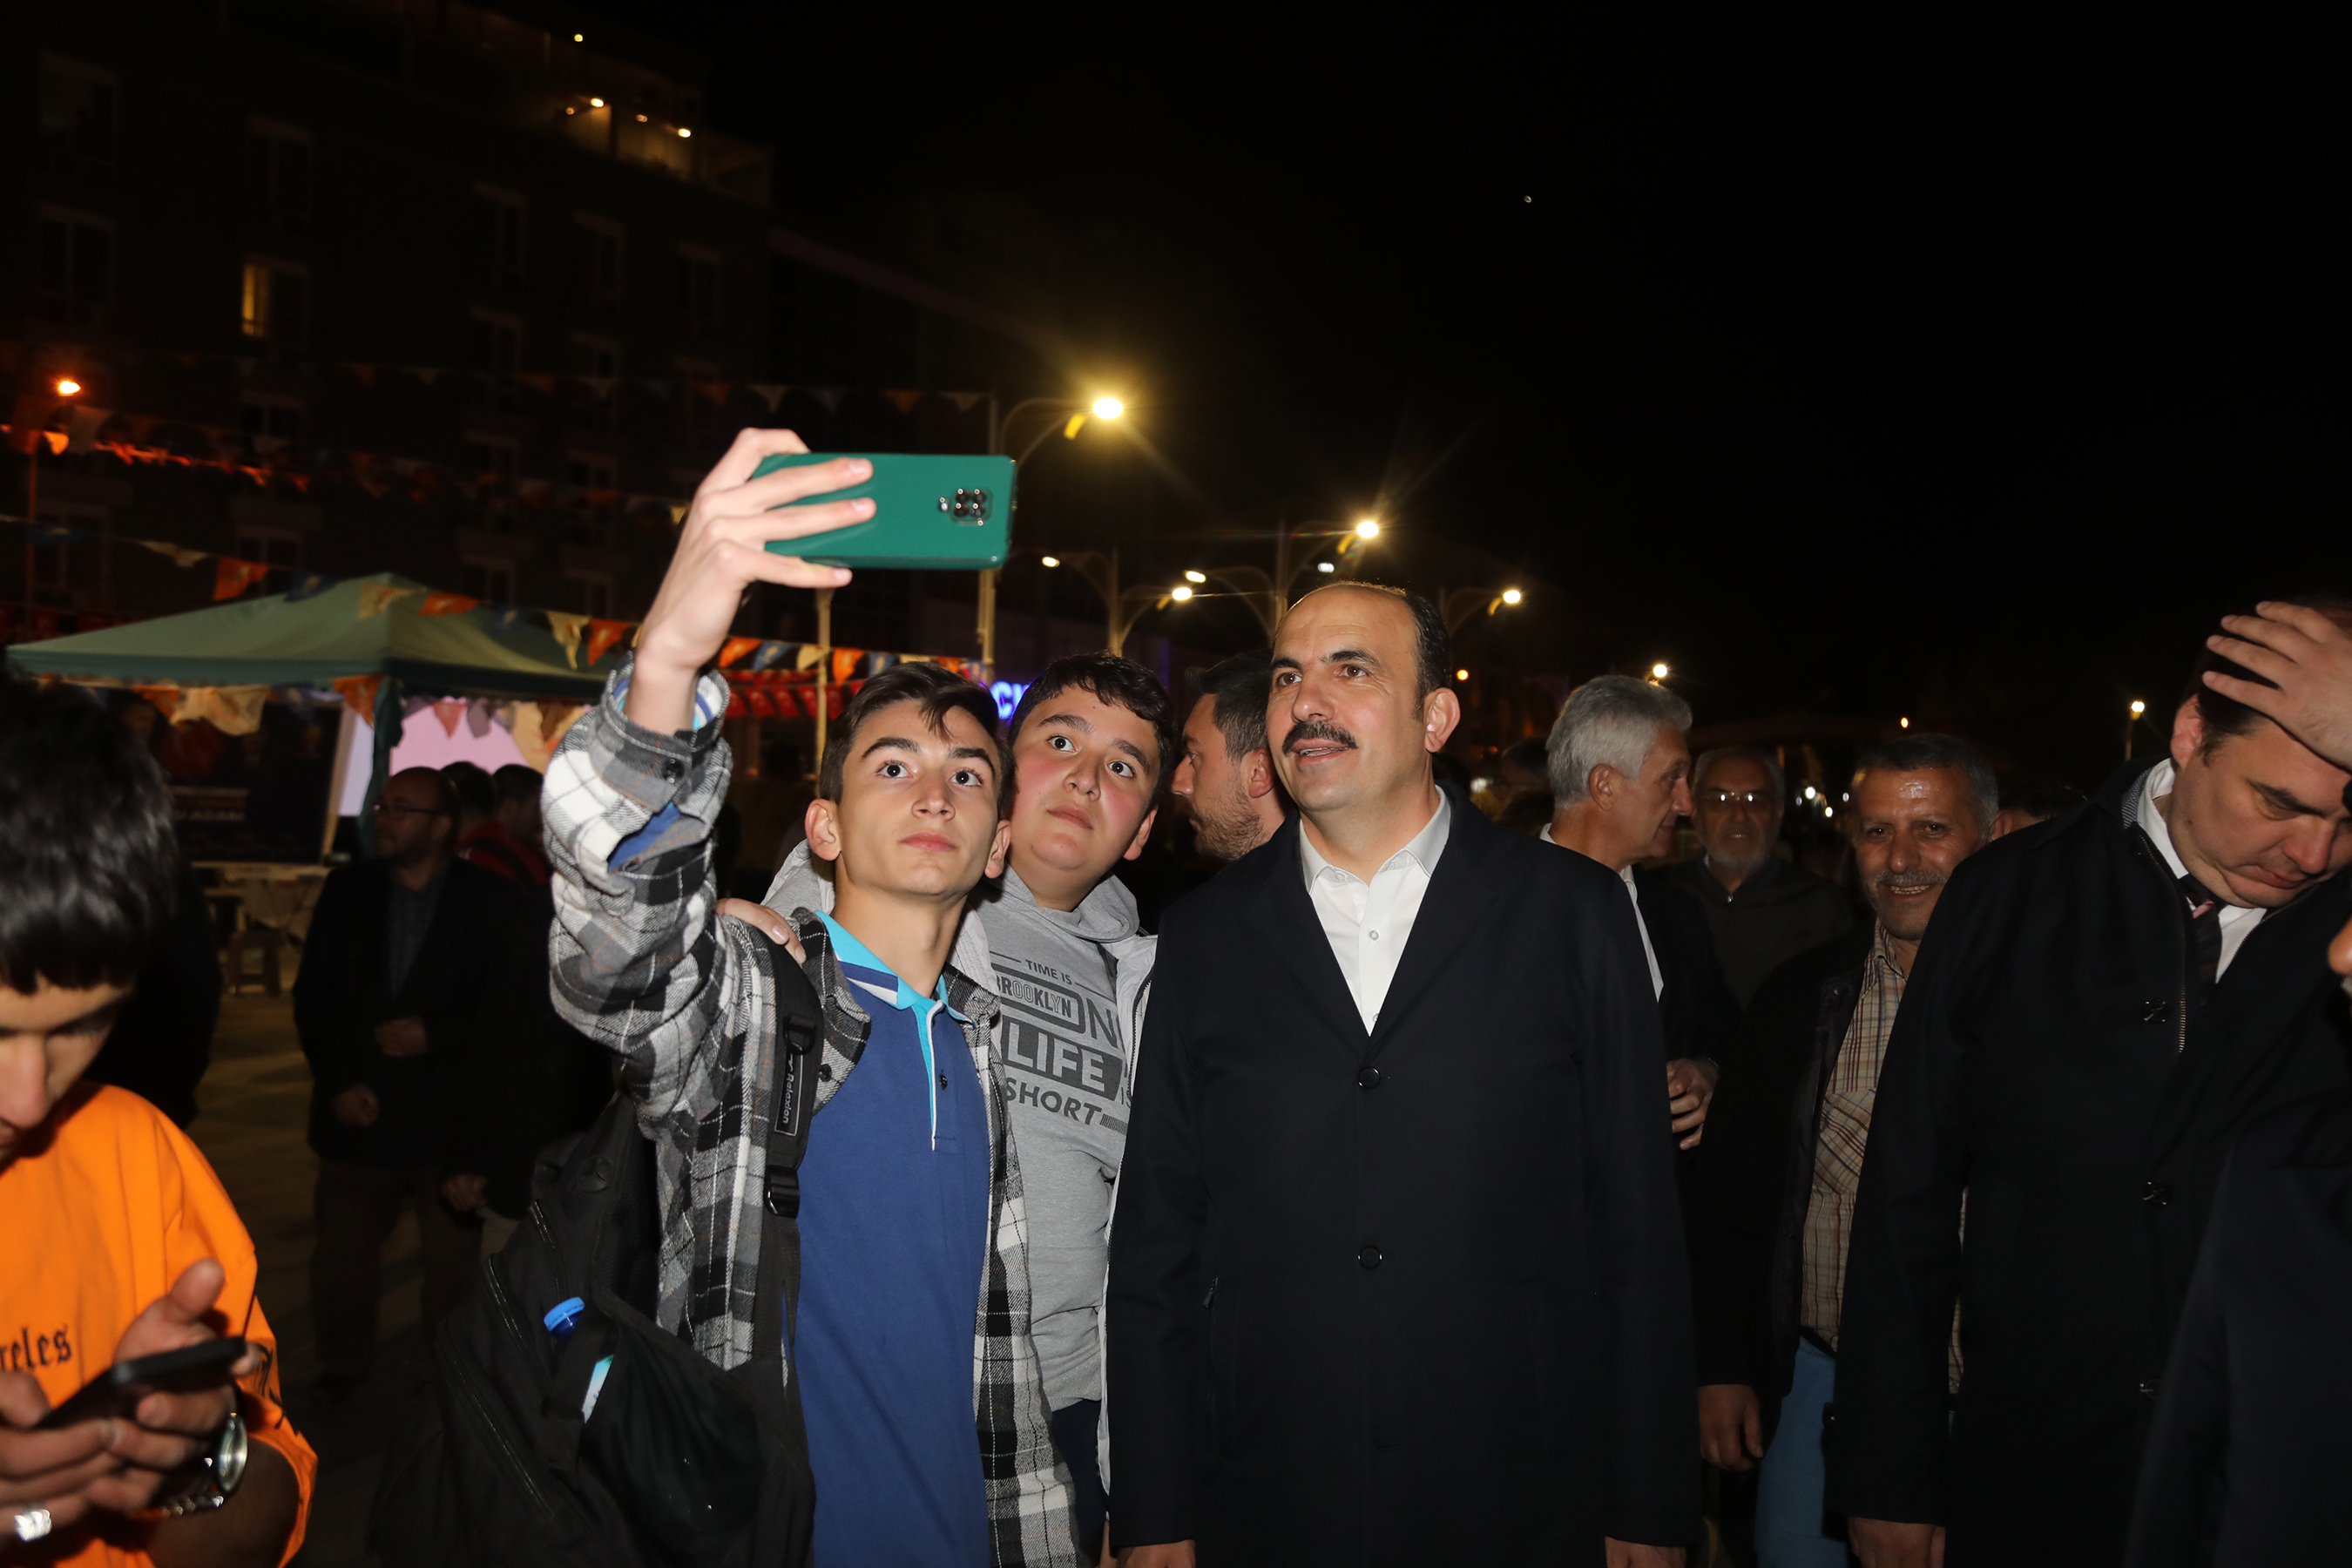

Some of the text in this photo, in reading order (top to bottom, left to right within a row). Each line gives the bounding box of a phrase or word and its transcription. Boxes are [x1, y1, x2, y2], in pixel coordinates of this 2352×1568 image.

[1025, 959, 1072, 985] TIME IS
[1008, 1022, 1105, 1092] LIFE
[782, 1073, 794, 1124] Relaxion
[1006, 1077, 1102, 1125] SHORT
